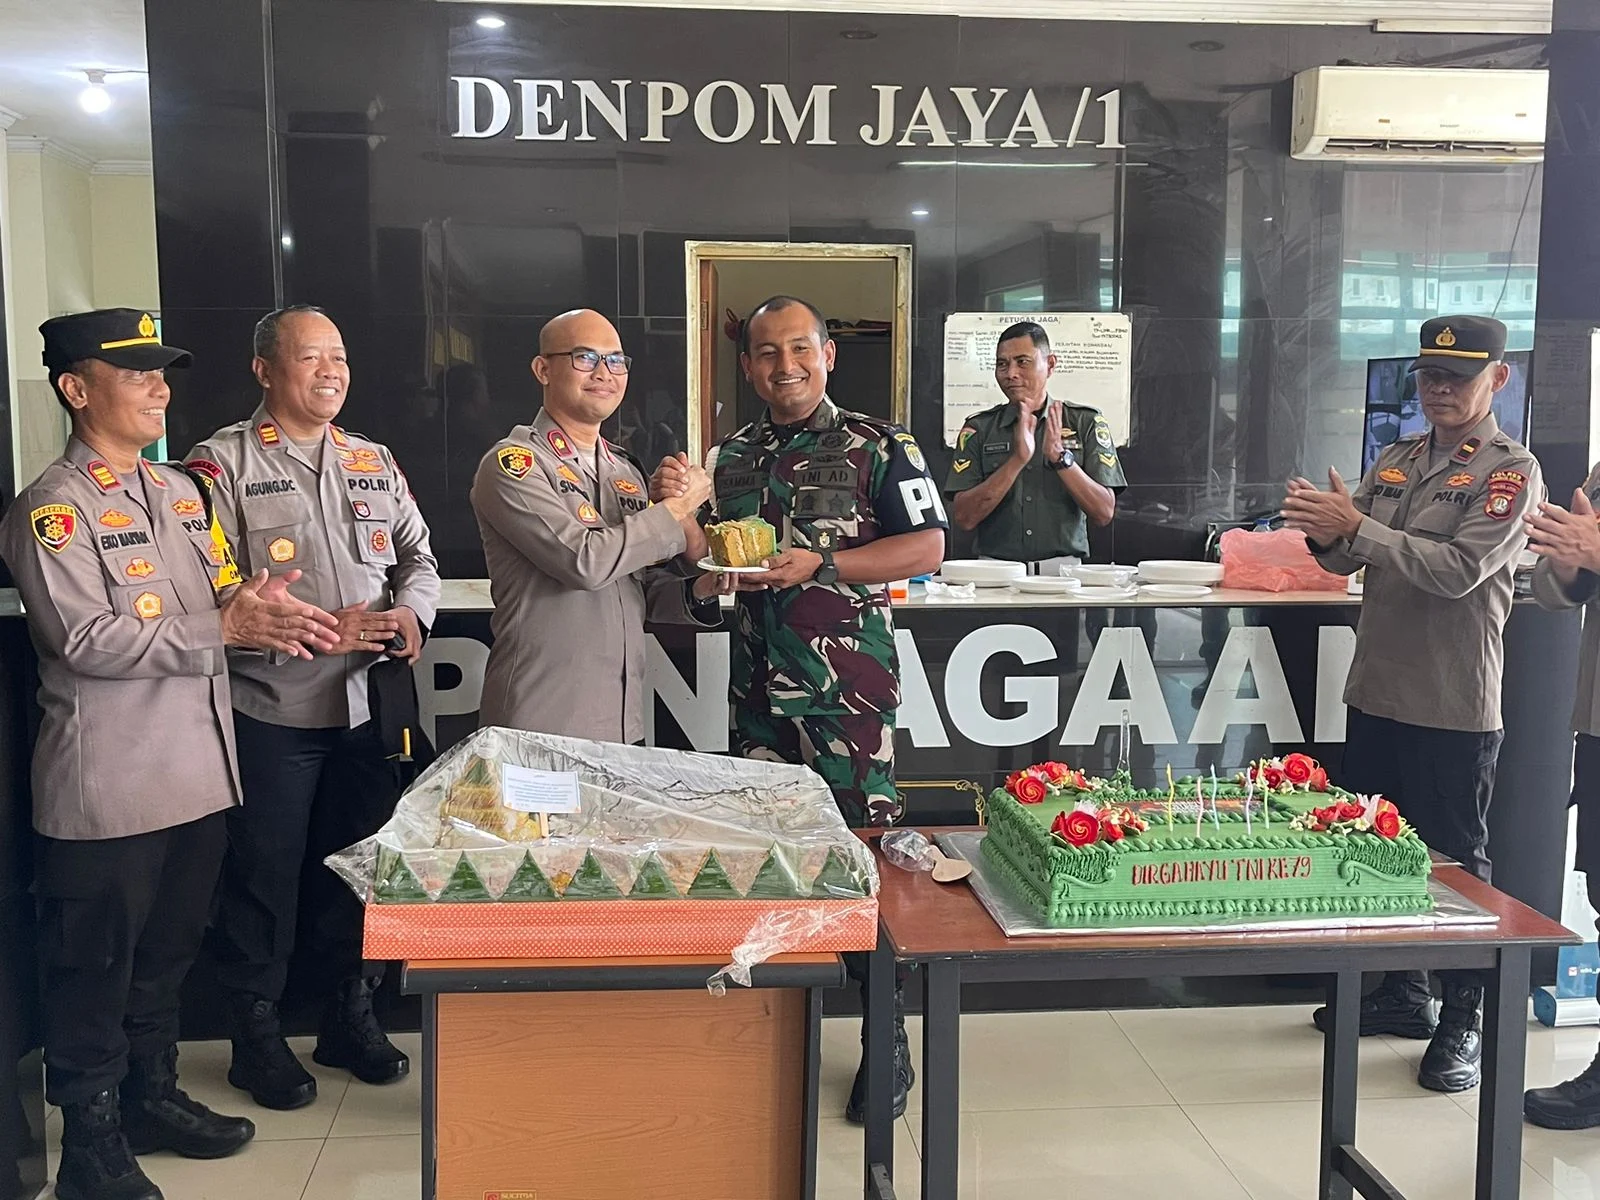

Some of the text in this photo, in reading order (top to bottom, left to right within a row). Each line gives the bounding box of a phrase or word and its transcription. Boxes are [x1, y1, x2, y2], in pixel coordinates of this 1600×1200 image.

[450, 76, 1126, 149] DENPOM JAYA/1
[347, 478, 390, 492] POLRI
[181, 518, 210, 533] POL
[1230, 858, 1263, 881] TNI
